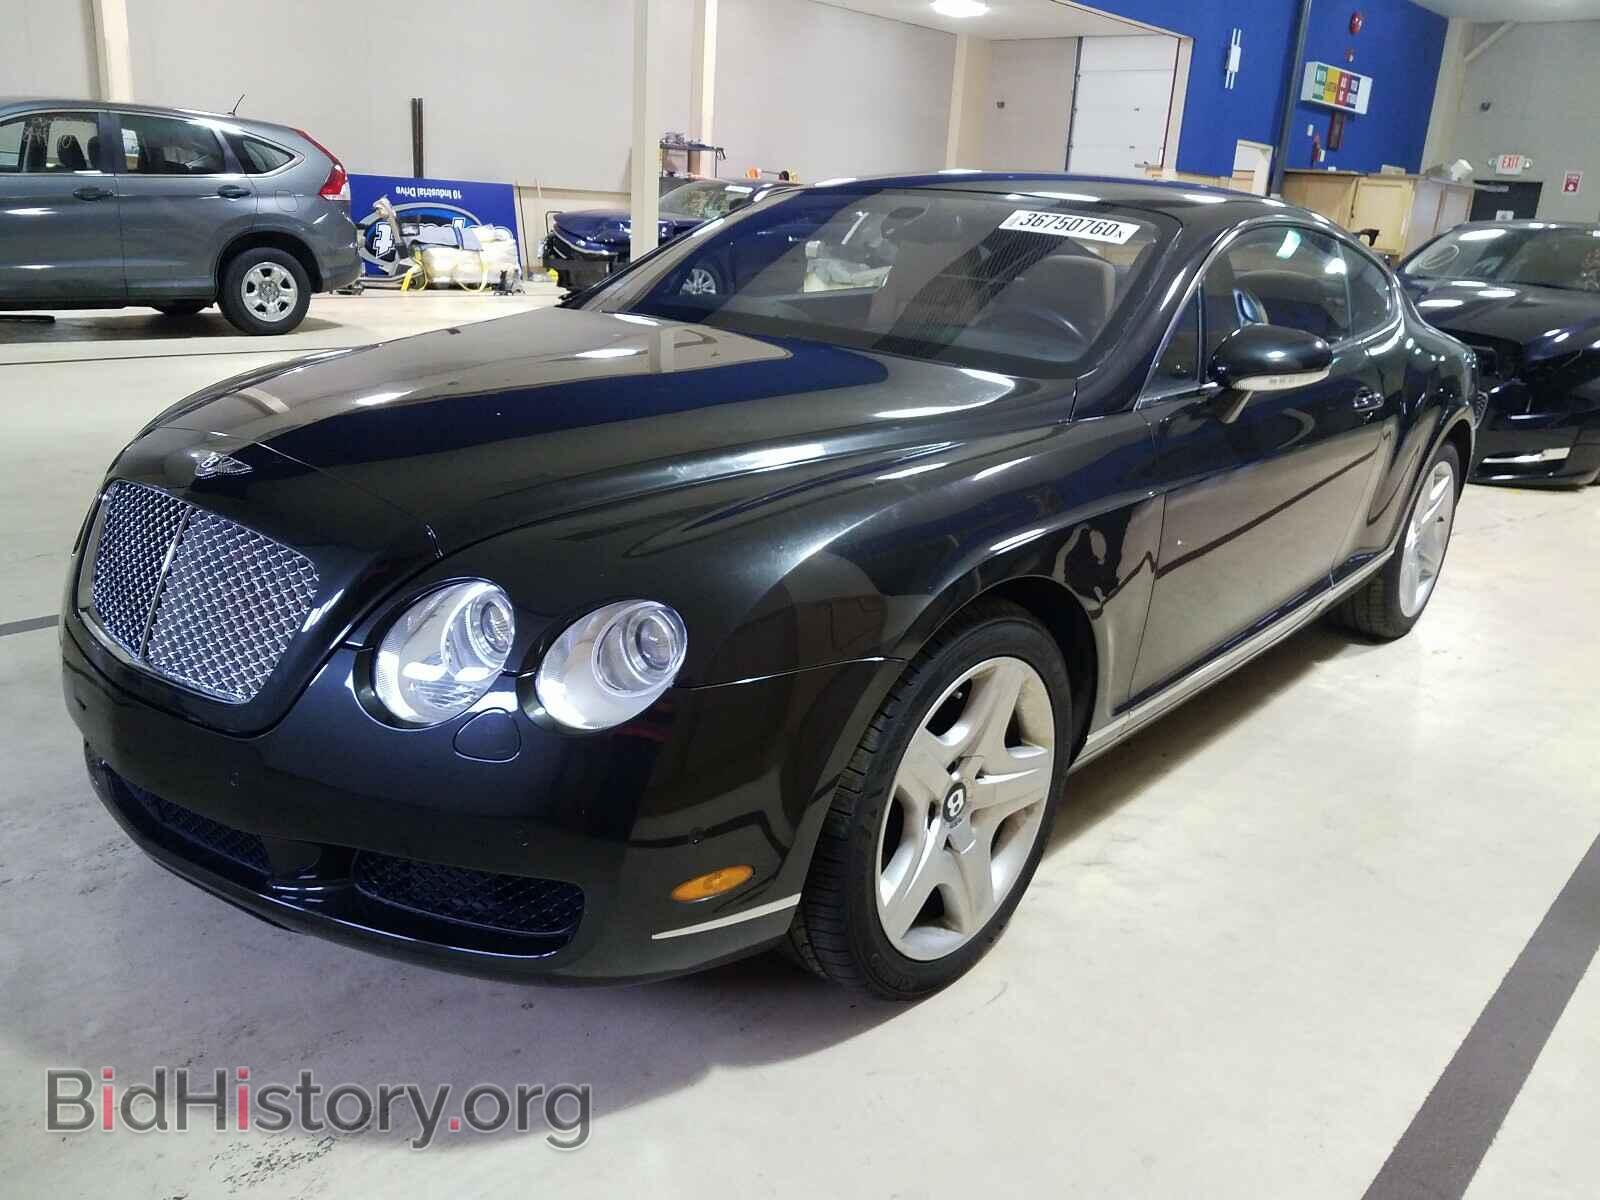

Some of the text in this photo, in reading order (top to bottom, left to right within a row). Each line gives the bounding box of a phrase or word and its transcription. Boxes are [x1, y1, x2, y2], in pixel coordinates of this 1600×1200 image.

[1502, 155, 1520, 168] EXIT
[395, 186, 463, 199] 10 Industrial Drive
